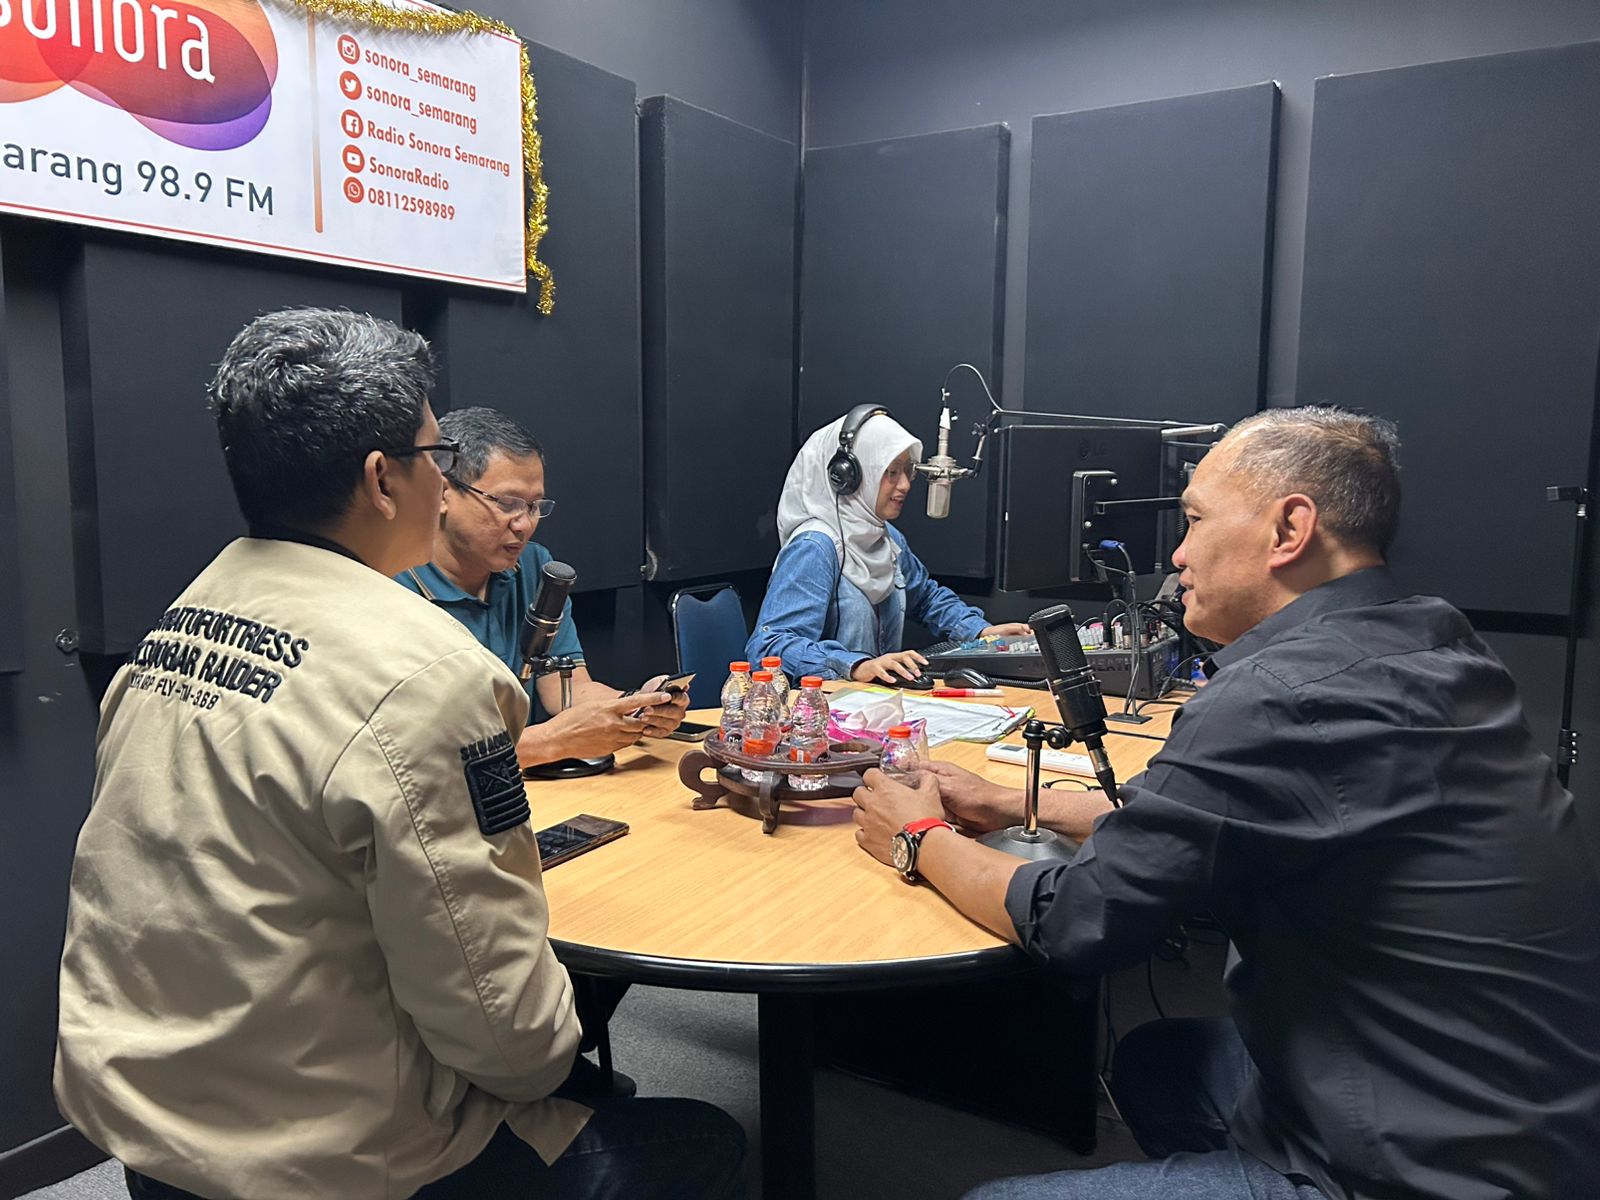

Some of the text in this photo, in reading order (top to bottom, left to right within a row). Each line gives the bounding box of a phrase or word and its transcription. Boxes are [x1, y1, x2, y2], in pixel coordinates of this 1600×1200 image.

[365, 49, 476, 102] sonora_semarang
[366, 85, 477, 135] sonora_semarang
[367, 120, 510, 177] Radio Sonora Semarang
[369, 157, 449, 190] SonoraRadio
[137, 160, 212, 202] 98.9
[226, 177, 273, 215] FM
[368, 187, 455, 220] 08112598989
[198, 650, 282, 704] RAIDER
